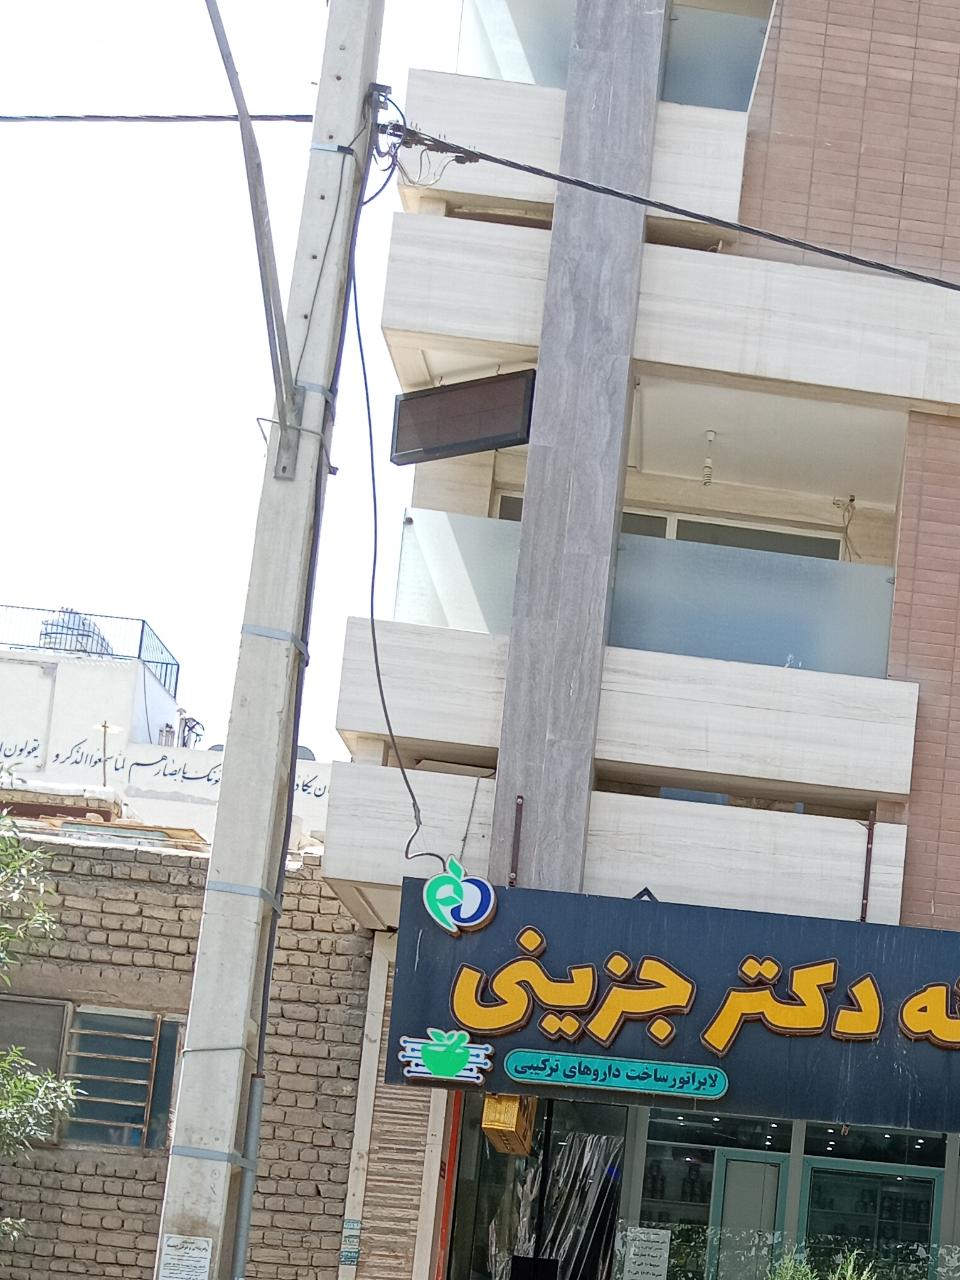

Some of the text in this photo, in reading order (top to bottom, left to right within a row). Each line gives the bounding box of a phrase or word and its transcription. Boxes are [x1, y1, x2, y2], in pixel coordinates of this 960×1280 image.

[449, 925, 697, 1048] جزینی
[700, 953, 883, 1058] دکتر
[514, 1058, 560, 1077] ترکیبی
[562, 1061, 621, 1082] داروهای
[625, 1064, 668, 1083] ساخت
